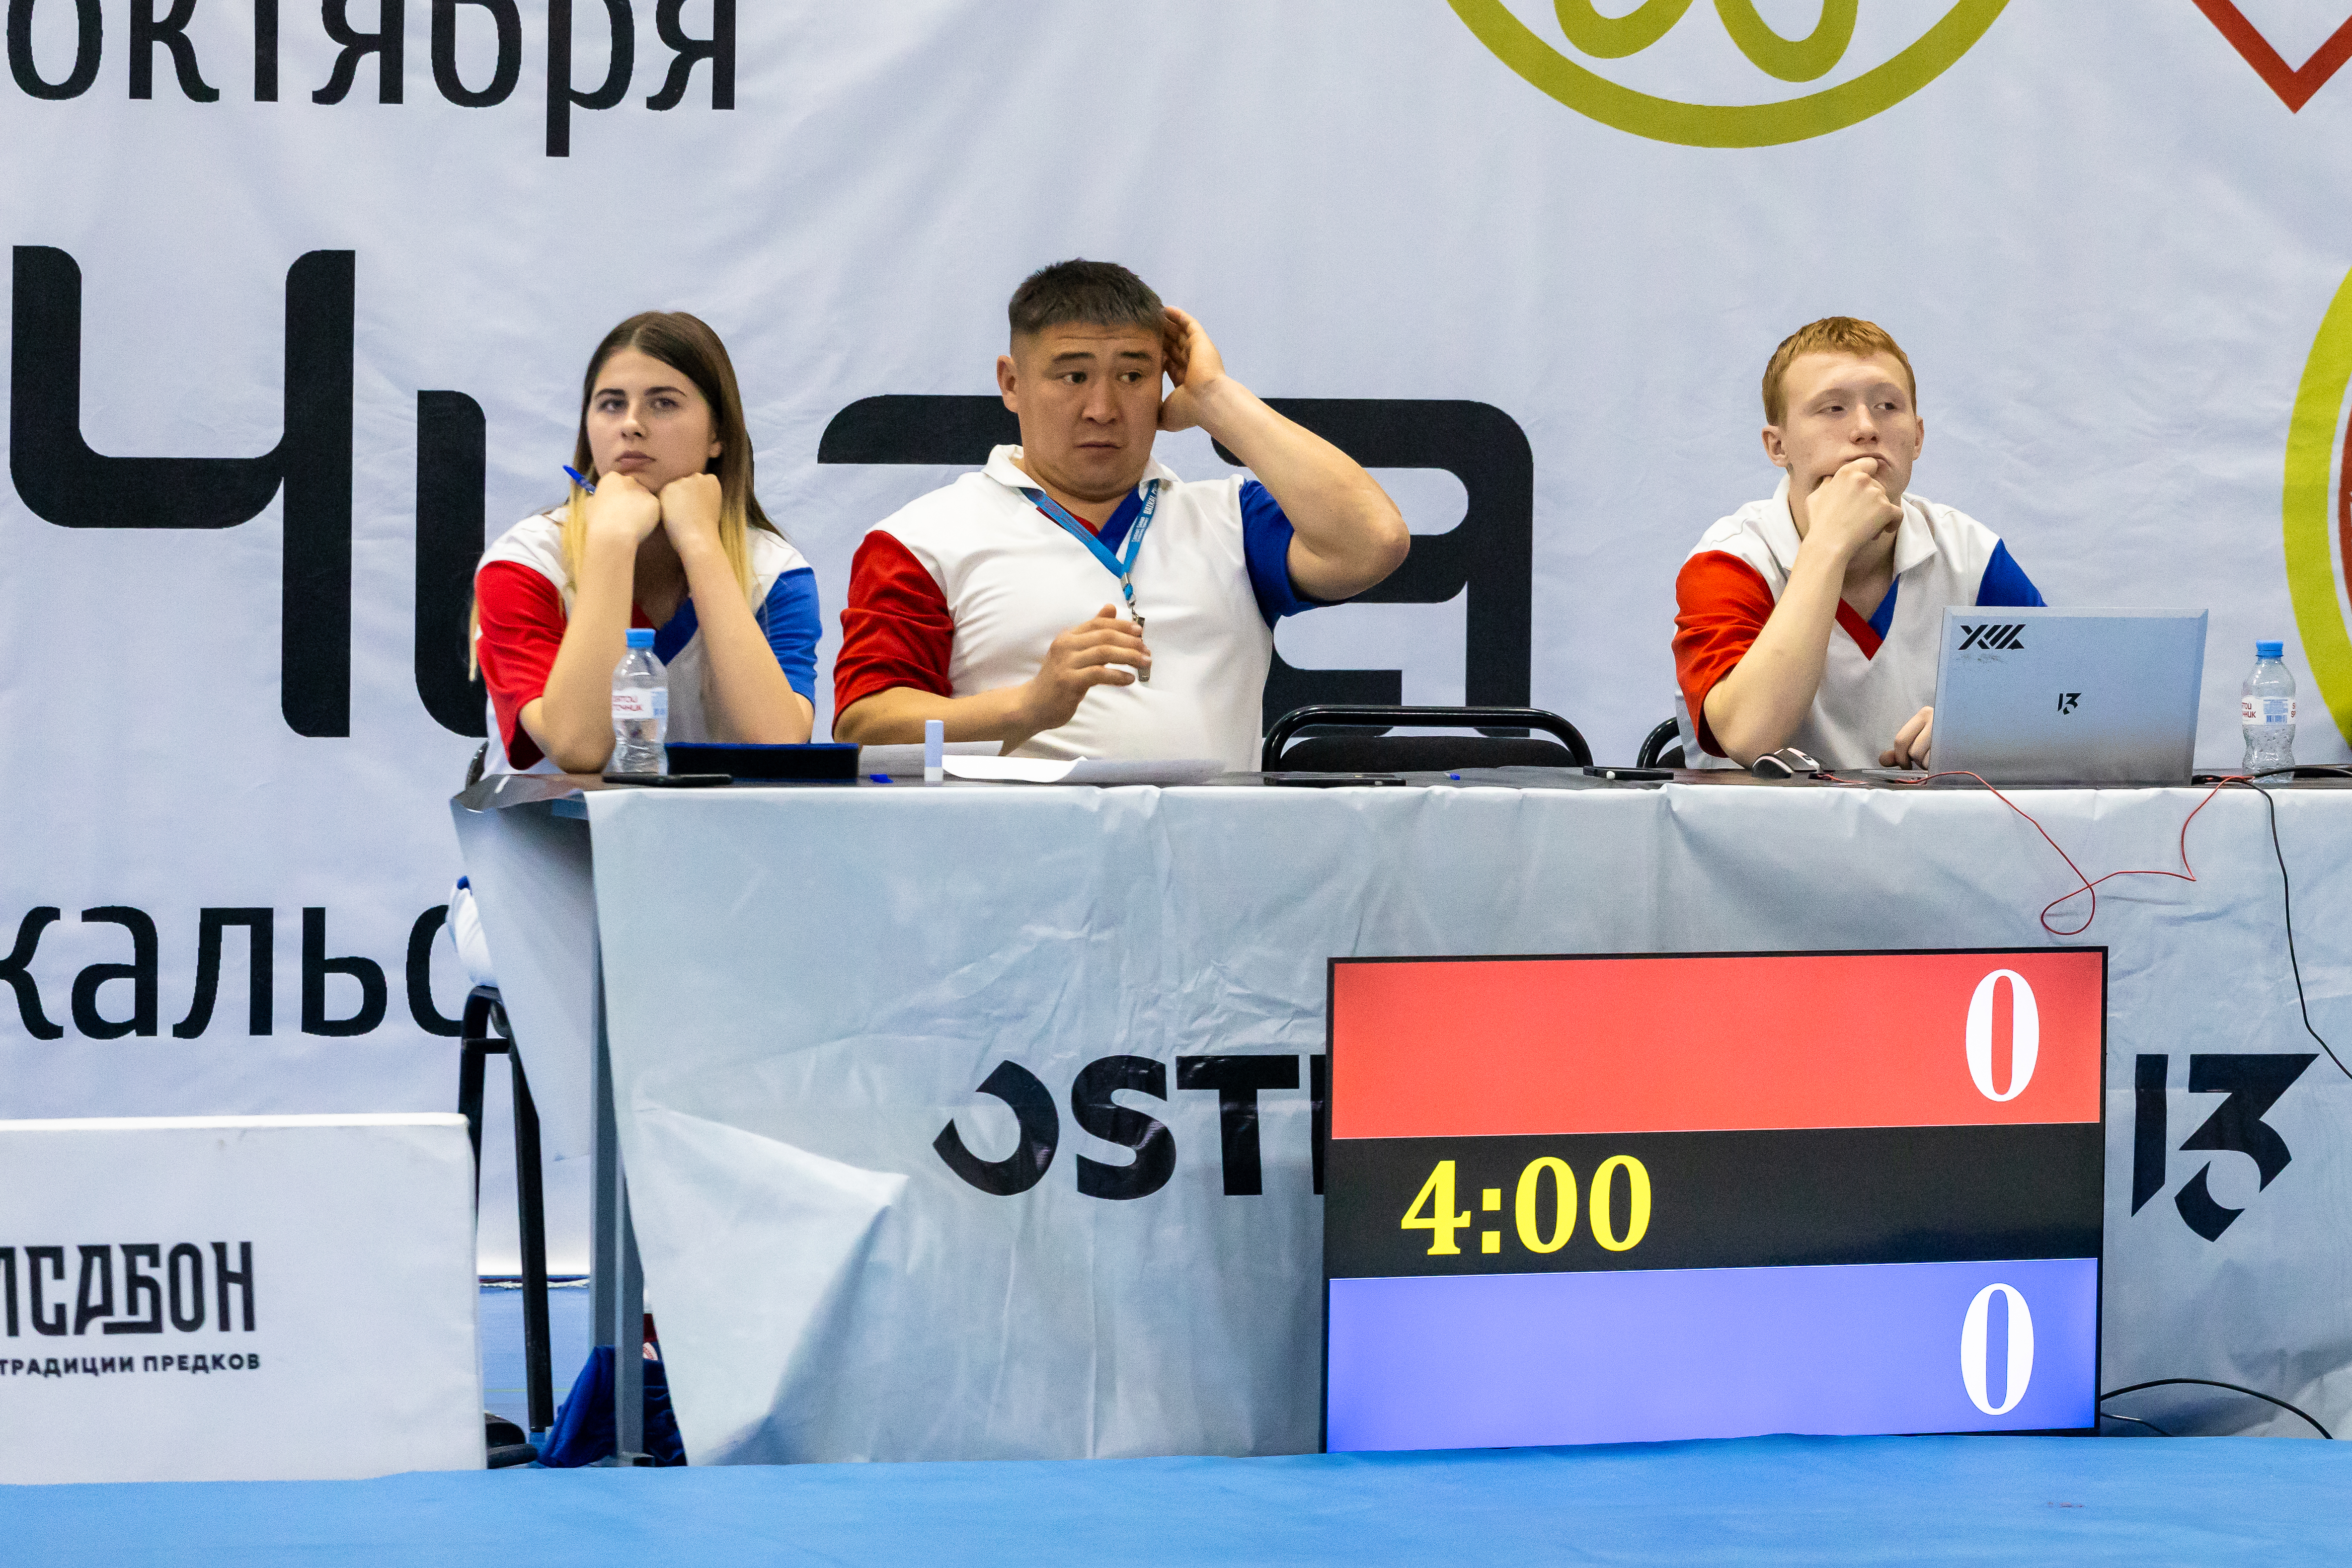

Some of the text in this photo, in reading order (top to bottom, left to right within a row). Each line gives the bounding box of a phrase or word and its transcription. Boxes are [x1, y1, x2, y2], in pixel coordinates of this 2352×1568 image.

[1966, 969, 2040, 1102] 0
[933, 1054, 1326, 1200] OST
[1401, 1155, 1651, 1255] 4:00
[0, 1353, 260, 1378] ТРАДИЦИИ ПРЕДКОВ
[1960, 1283, 2034, 1416] 0
